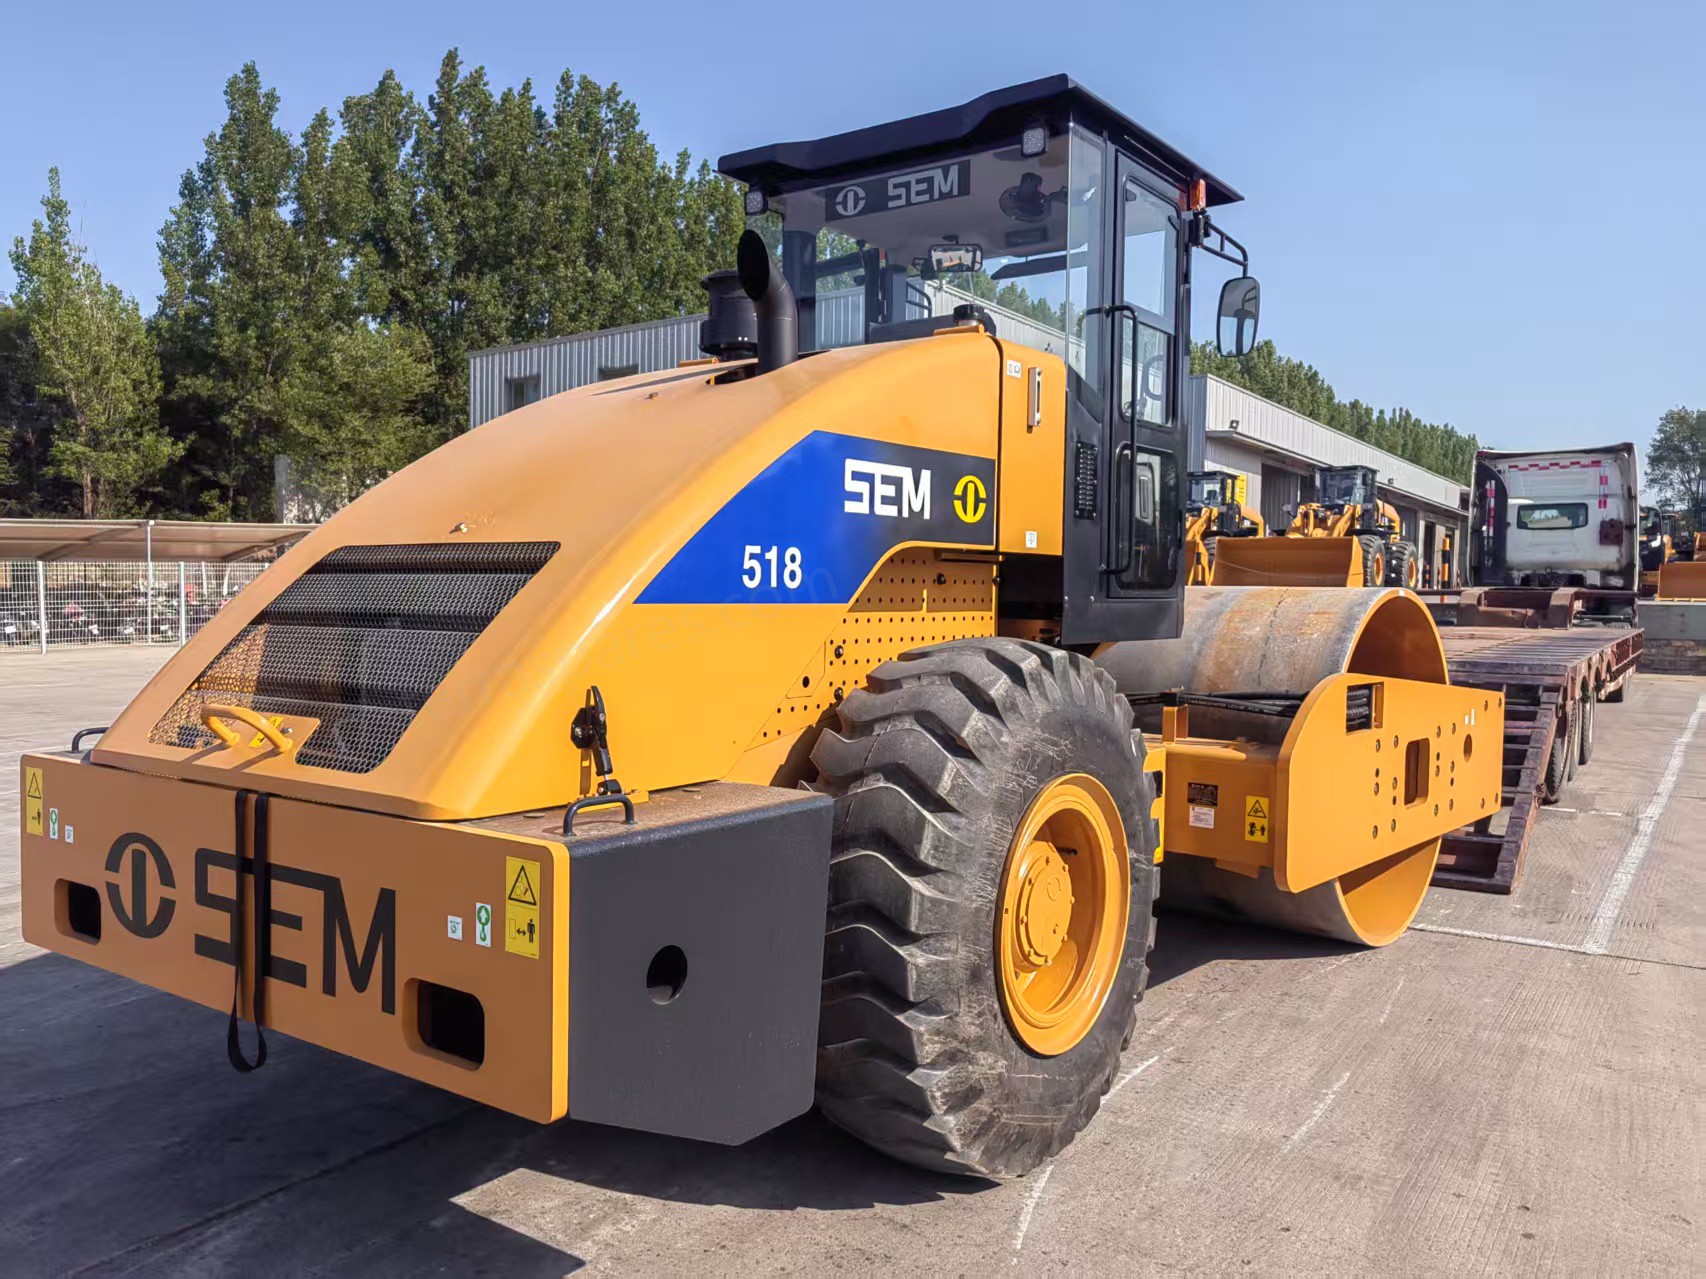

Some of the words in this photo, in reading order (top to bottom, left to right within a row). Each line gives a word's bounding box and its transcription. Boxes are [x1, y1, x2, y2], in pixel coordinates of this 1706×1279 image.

[888, 164, 959, 208] SEM
[844, 458, 931, 519] SEM
[742, 545, 802, 589] 518
[194, 847, 396, 1015] SEM
